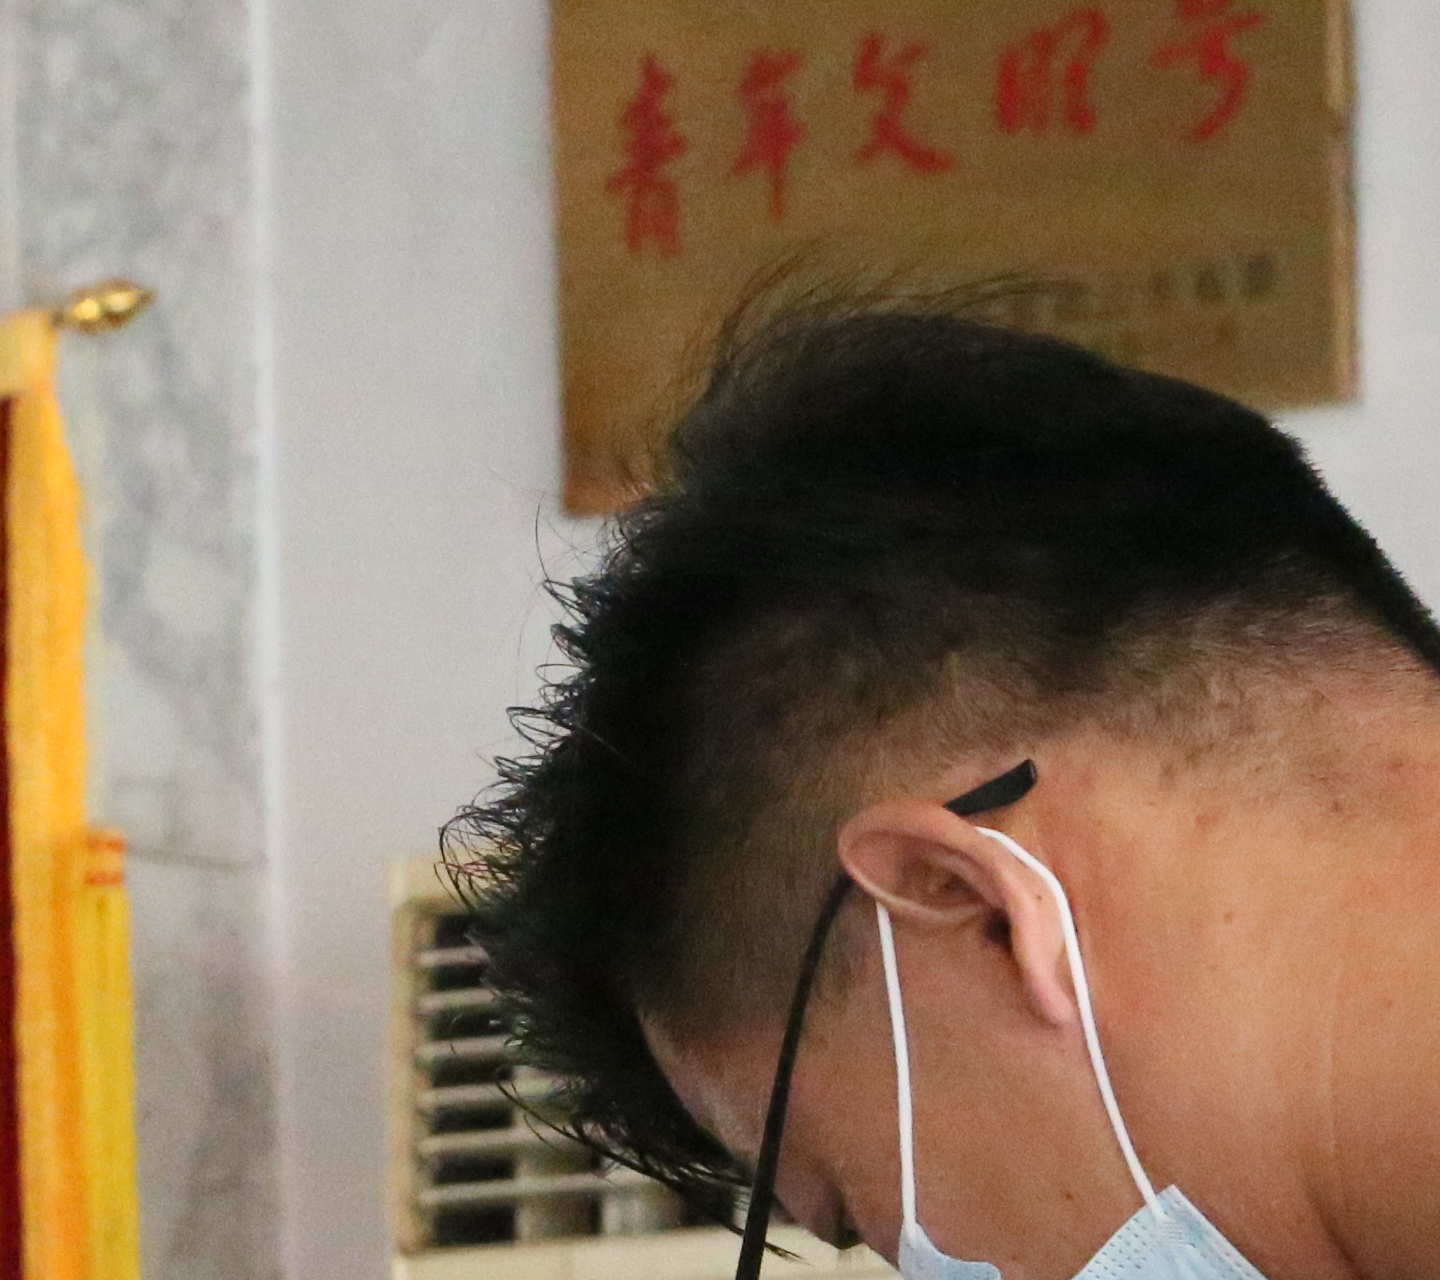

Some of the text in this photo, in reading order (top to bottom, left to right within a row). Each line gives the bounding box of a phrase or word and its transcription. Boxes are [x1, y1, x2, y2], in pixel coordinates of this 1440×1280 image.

[607, 0, 1266, 256] 青年文明号
